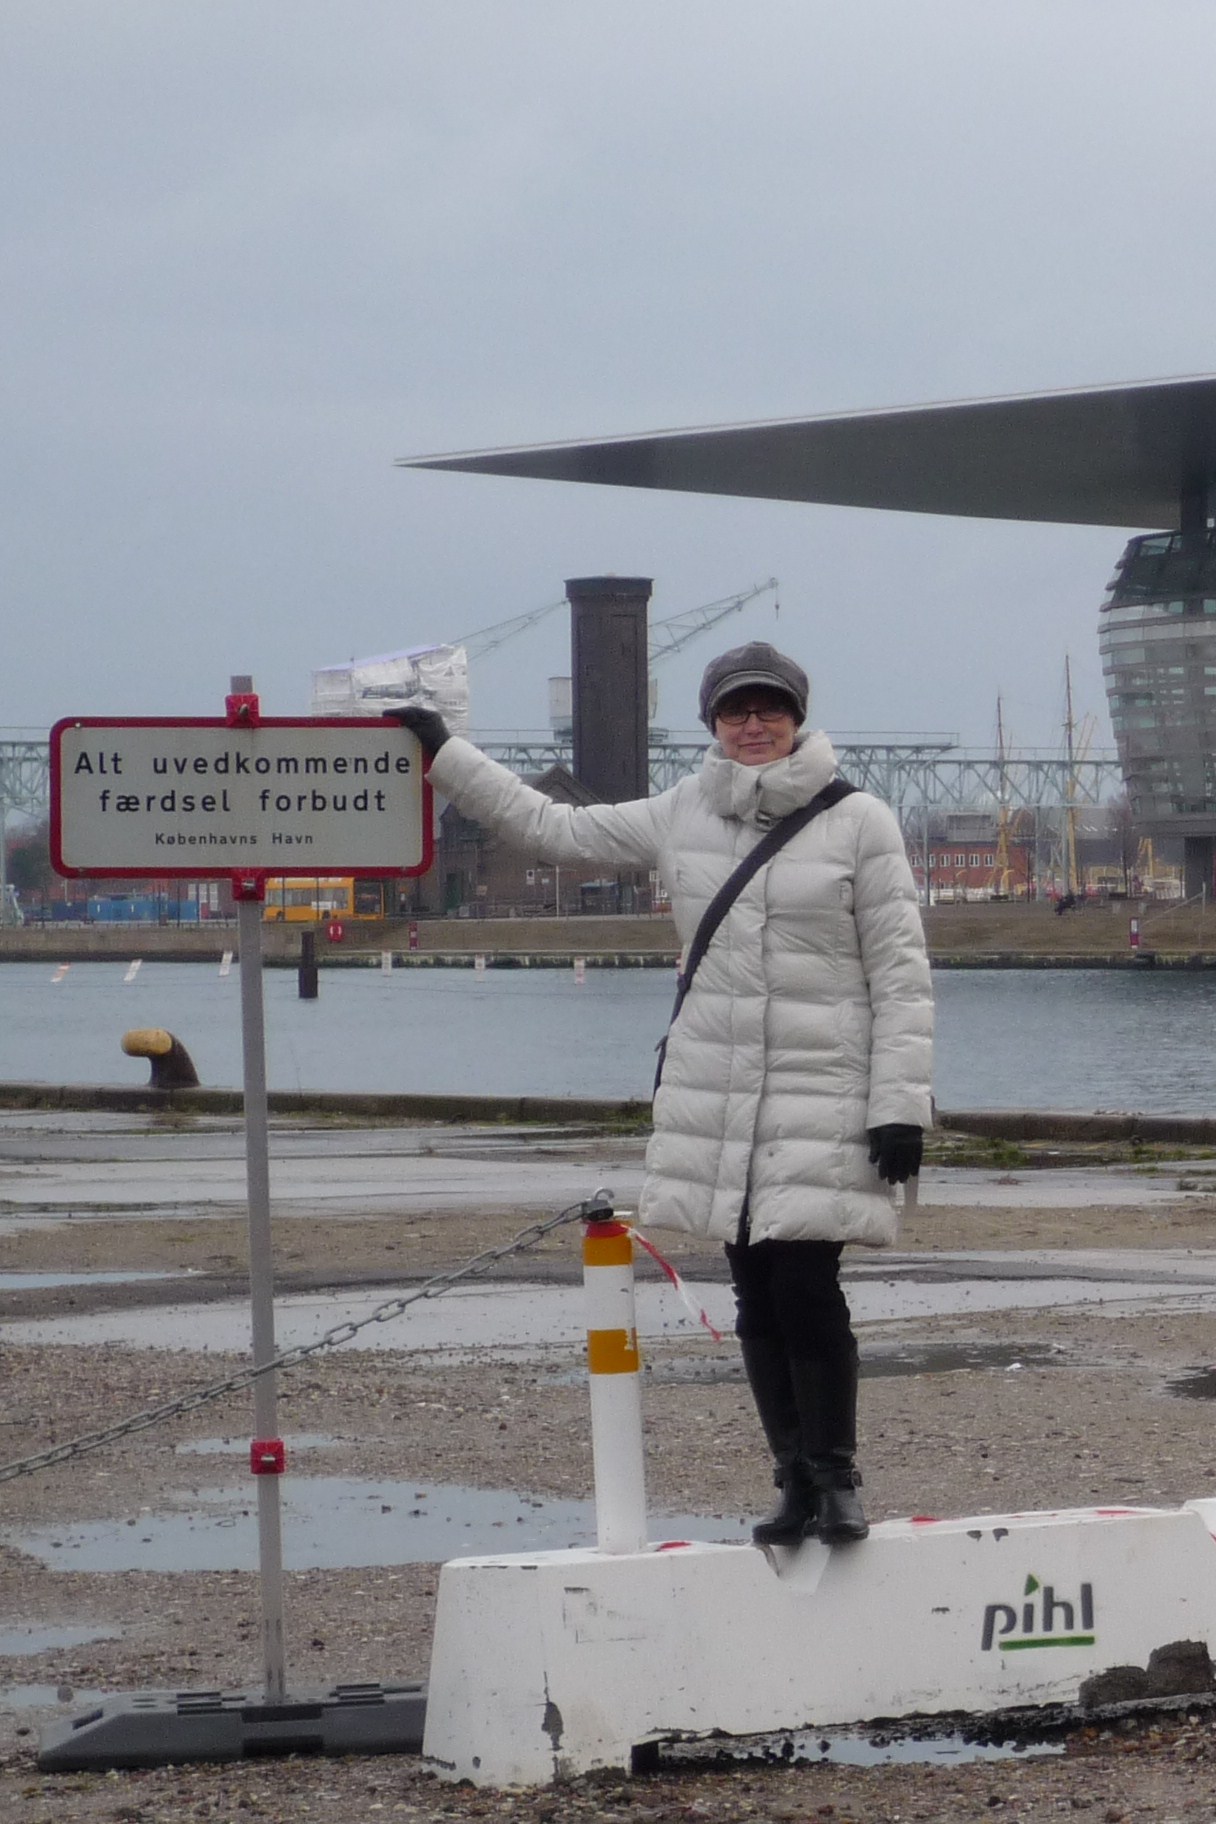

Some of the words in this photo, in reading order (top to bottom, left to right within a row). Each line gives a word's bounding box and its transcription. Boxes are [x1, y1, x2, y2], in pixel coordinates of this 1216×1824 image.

[74, 751, 122, 774] Alt
[153, 751, 410, 774] uvedkommende
[99, 788, 230, 812] færdsel
[259, 788, 386, 811] forbudt
[155, 832, 258, 845] Københavns
[272, 832, 313, 845] Havn
[981, 1573, 1095, 1651] pihl
